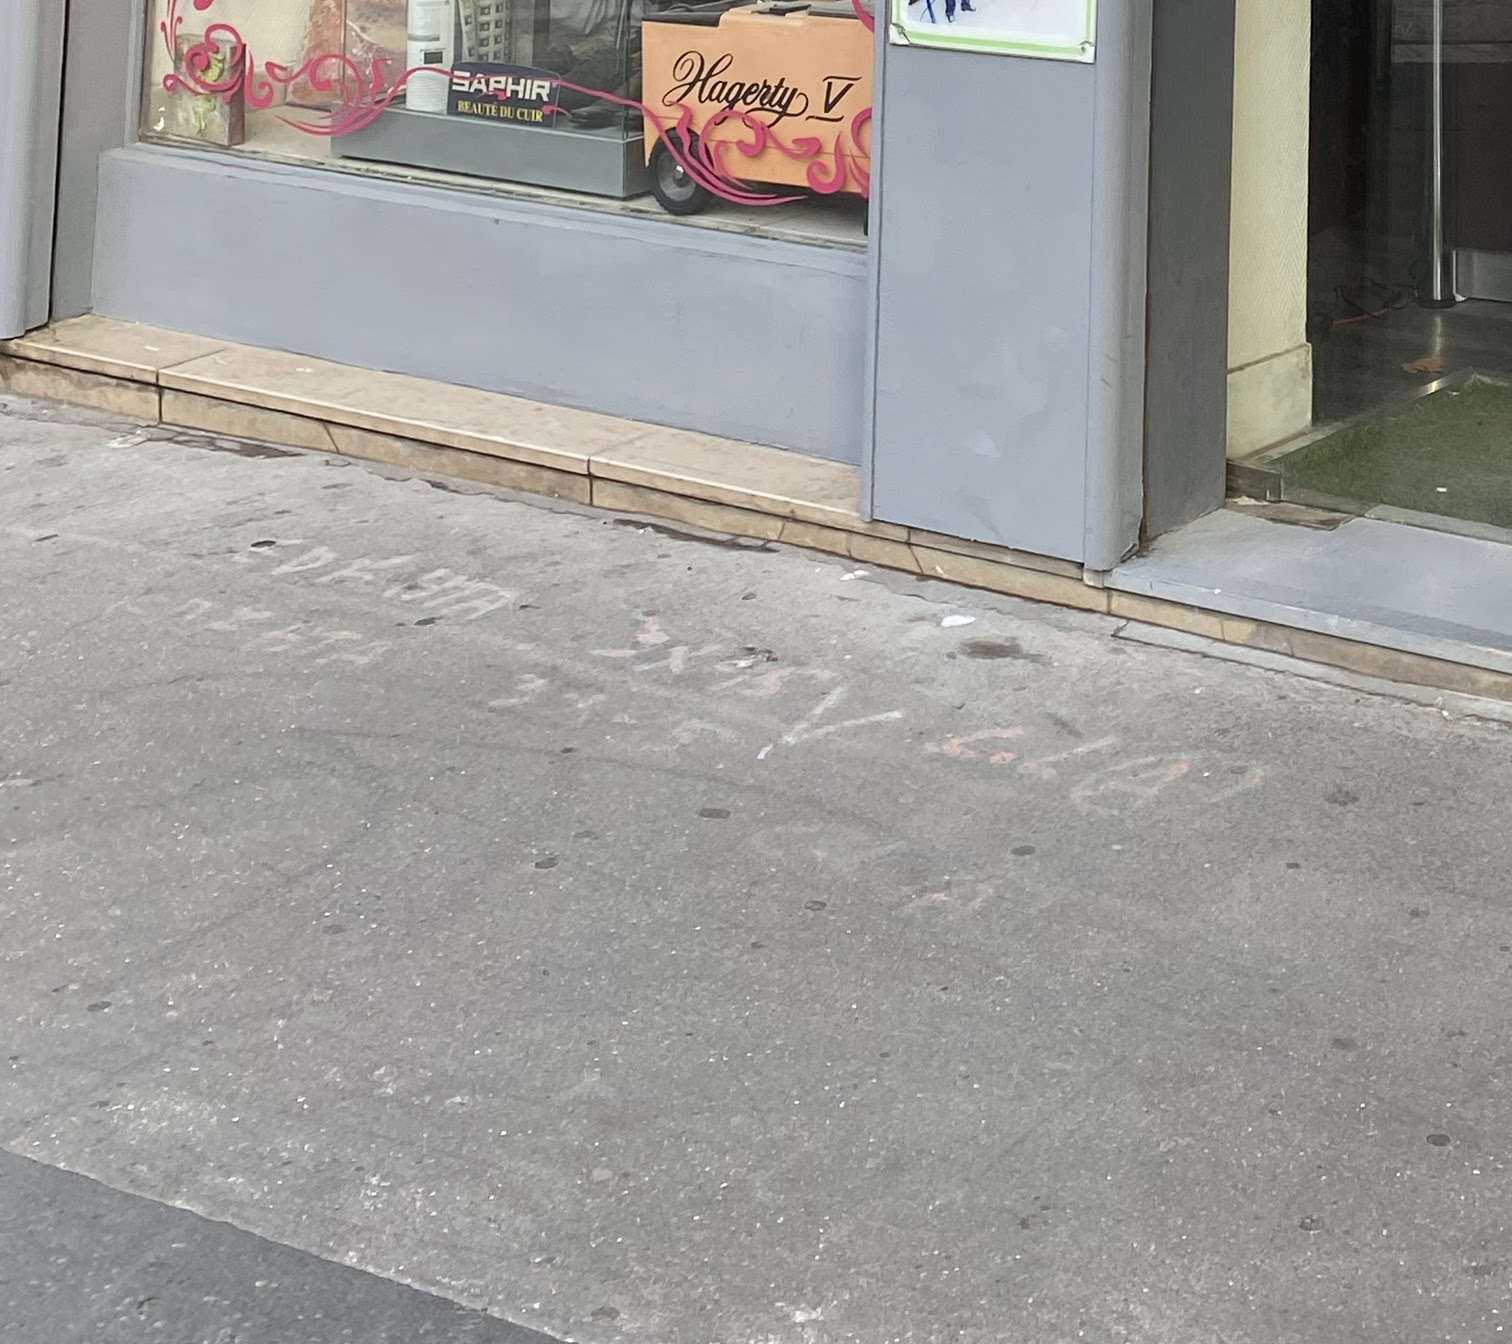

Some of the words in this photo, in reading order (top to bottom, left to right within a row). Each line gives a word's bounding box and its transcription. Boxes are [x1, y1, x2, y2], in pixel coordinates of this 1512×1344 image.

[451, 70, 551, 102] SAPHIR
[662, 50, 809, 130] Hagerty
[457, 100, 499, 117] BEAUTÉ
[500, 105, 515, 119] DU
[516, 108, 543, 123] CUIR
